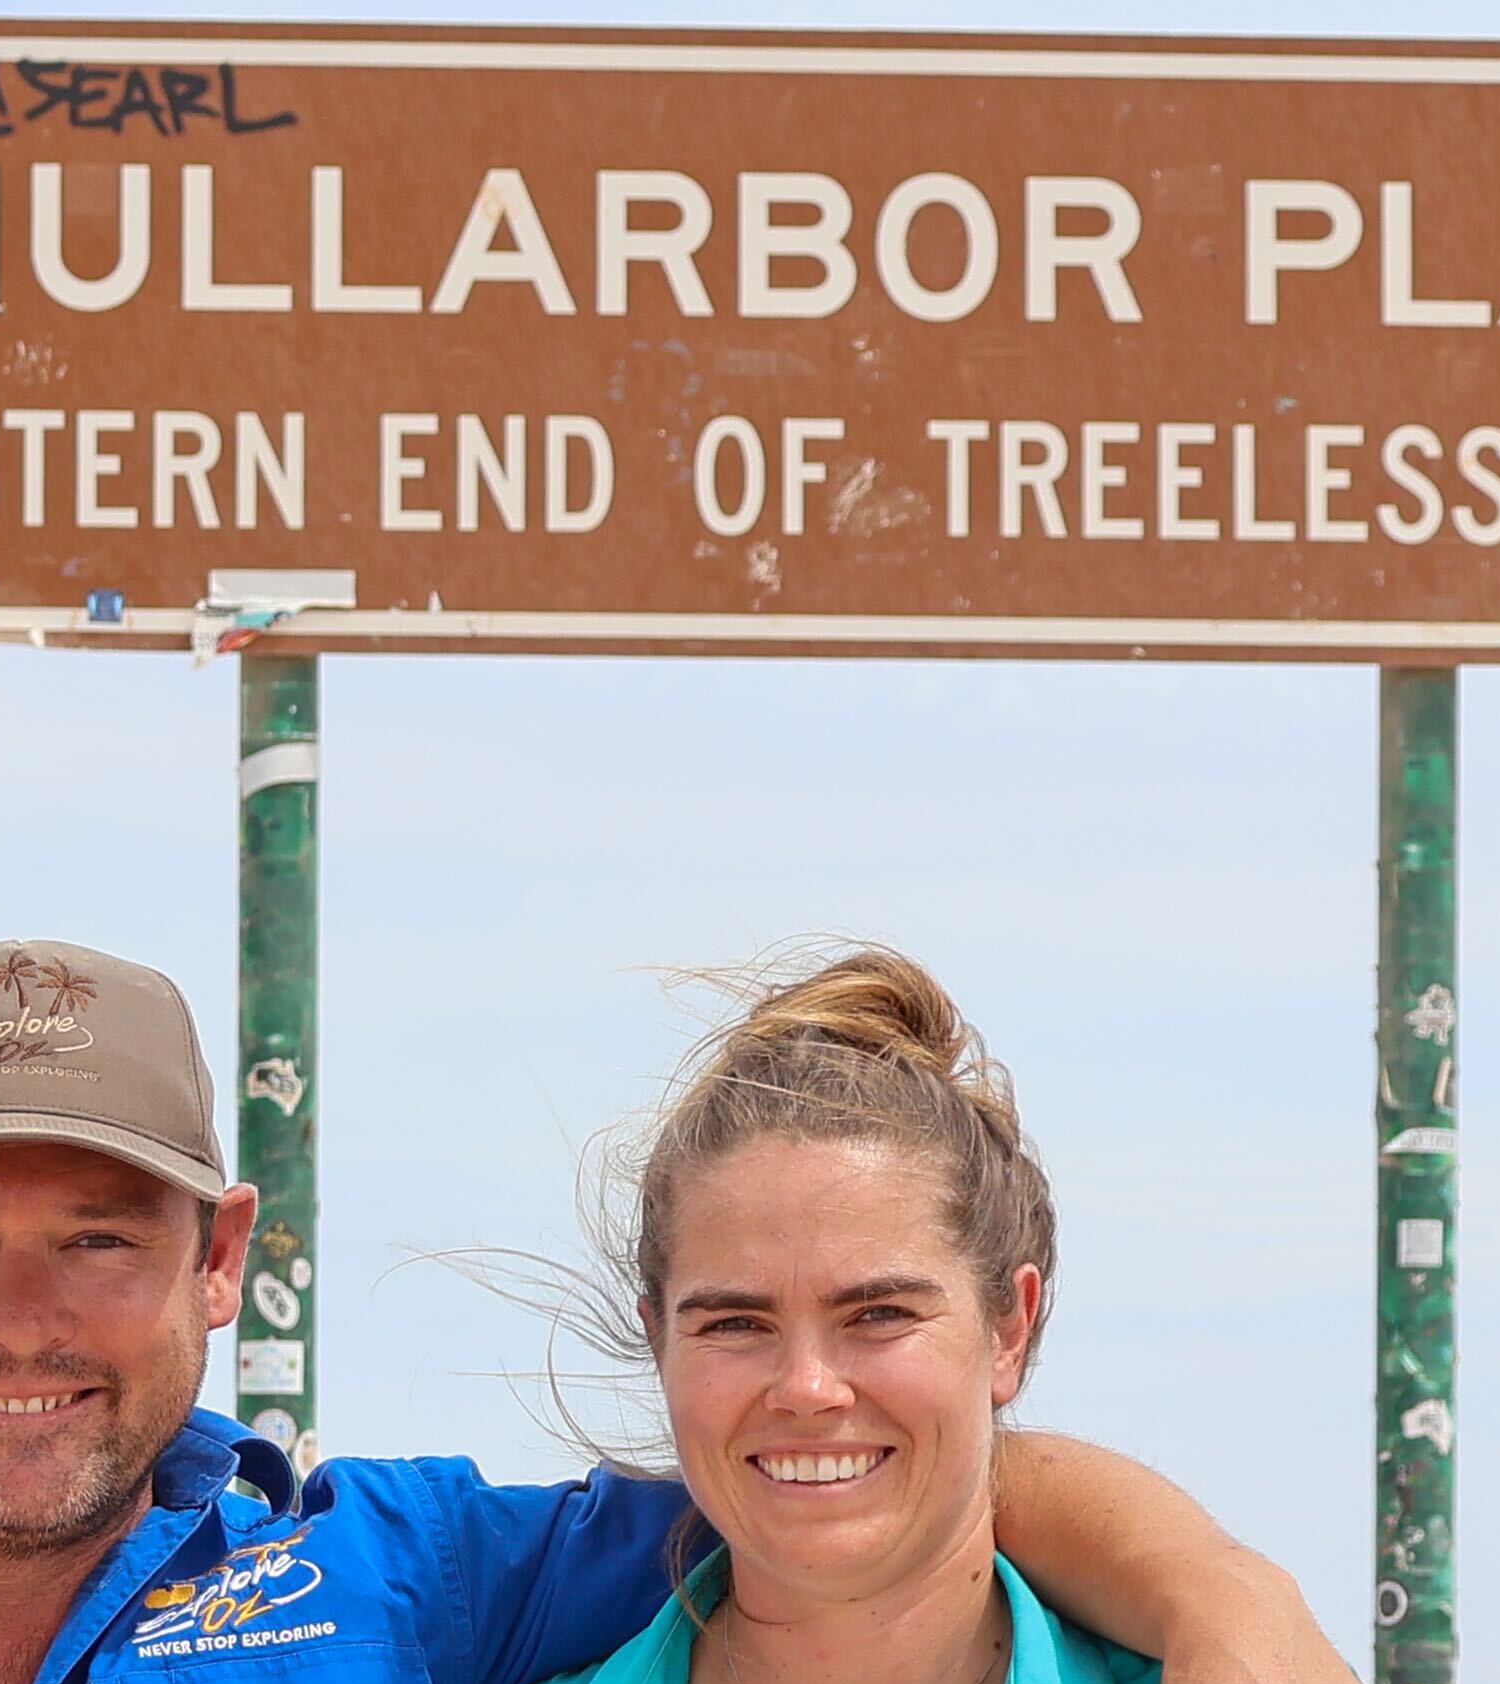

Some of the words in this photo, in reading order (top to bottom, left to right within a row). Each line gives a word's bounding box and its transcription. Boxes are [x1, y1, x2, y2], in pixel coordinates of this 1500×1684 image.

[18, 59, 298, 136] SEARL
[379, 412, 615, 534] END
[693, 414, 846, 538] OF
[23, 1064, 103, 1083] EXPLORING
[138, 1639, 192, 1659] NEVER
[196, 1633, 238, 1651] STOP
[241, 1621, 337, 1648] EXPLORING
